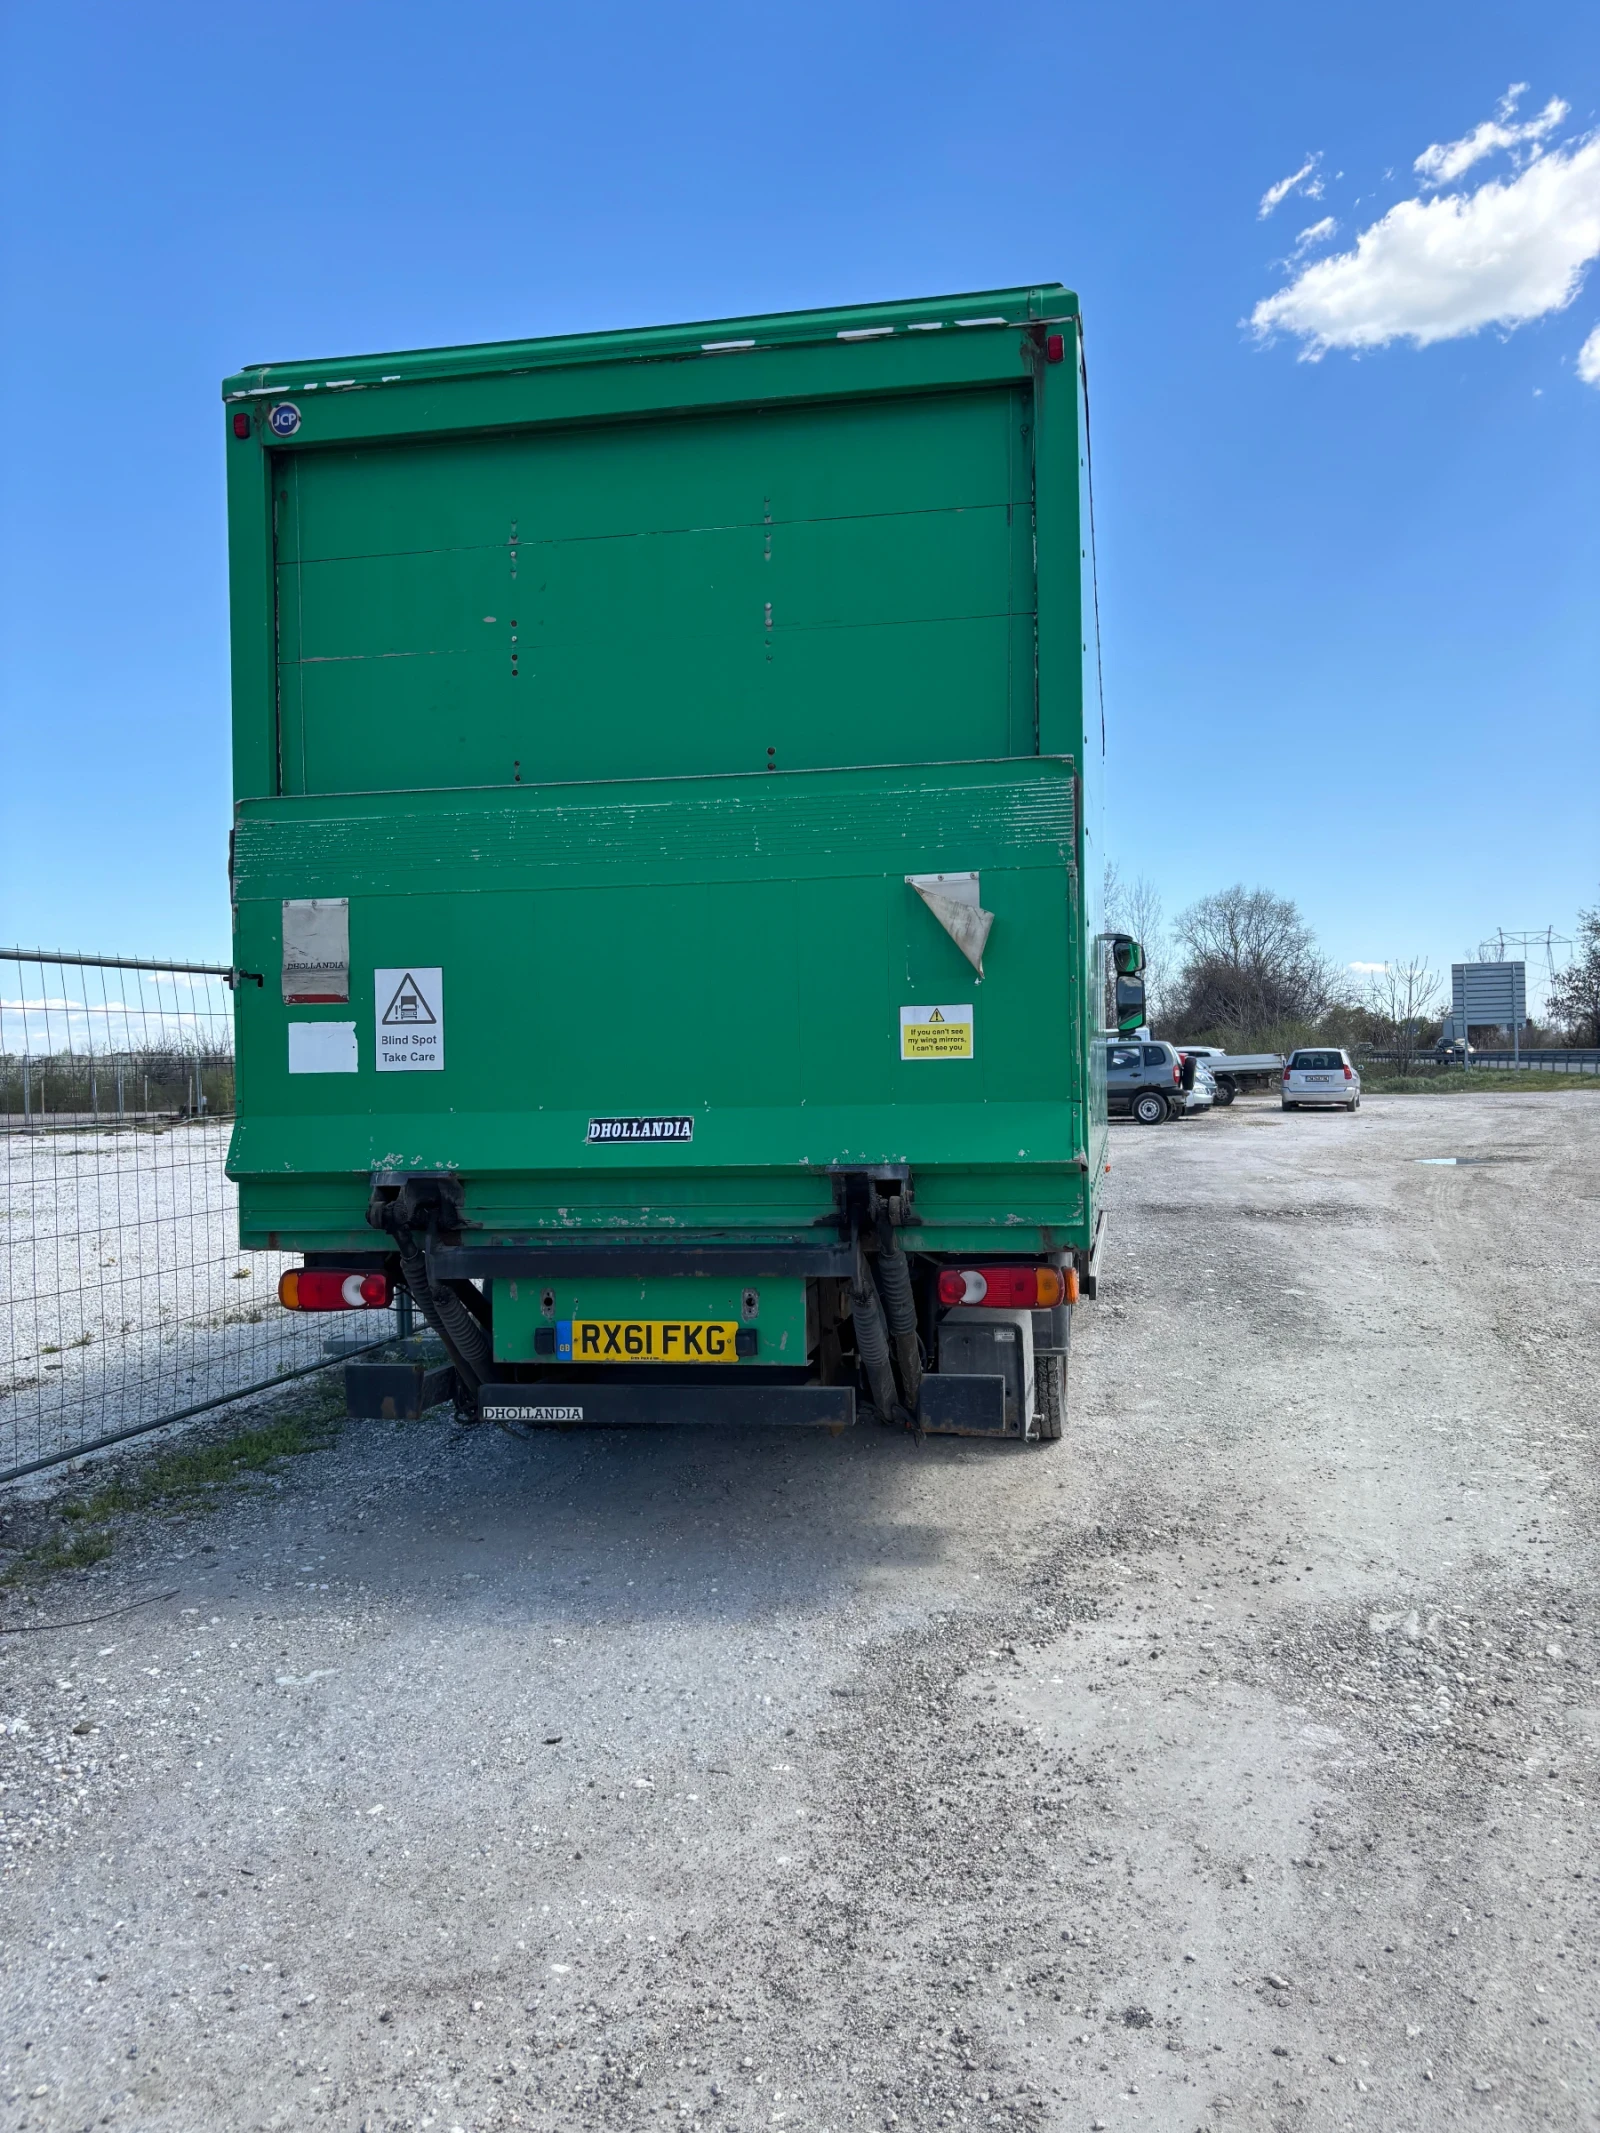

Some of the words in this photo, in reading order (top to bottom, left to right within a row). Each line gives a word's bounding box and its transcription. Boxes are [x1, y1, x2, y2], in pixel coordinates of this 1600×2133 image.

[274, 413, 297, 427] JCP
[286, 961, 345, 971] DHOLLANDIA
[382, 1035, 408, 1045] Blind
[412, 1034, 437, 1046] Spot
[382, 1052, 407, 1062] Take
[410, 1052, 436, 1062] Care
[590, 1122, 690, 1138] DHOLLANDIA
[581, 1324, 652, 1354] RX61
[662, 1324, 725, 1355] FKG
[559, 1344, 570, 1352] GB
[484, 1408, 581, 1419] DHOLLANDIA
